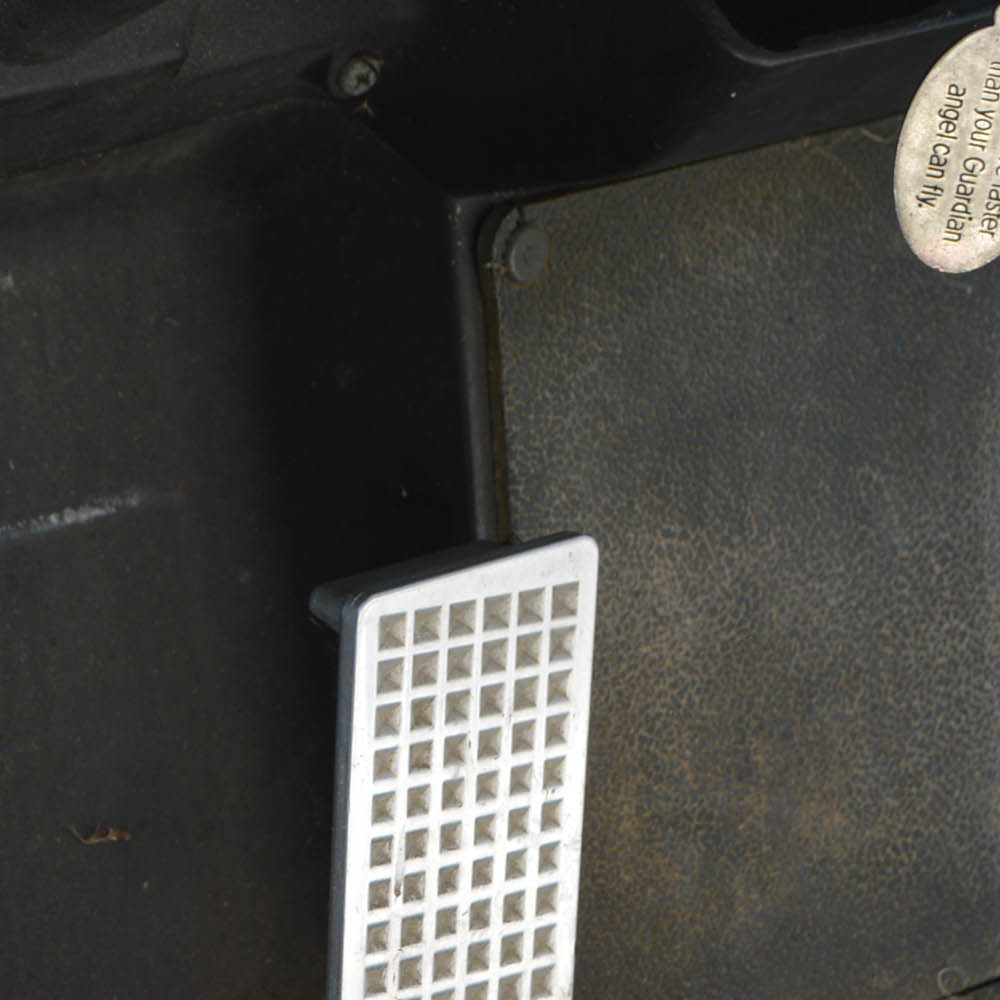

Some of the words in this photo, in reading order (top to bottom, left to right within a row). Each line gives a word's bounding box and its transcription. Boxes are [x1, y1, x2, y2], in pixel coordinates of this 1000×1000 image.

[936, 83, 966, 139] angel
[968, 107, 995, 151] your
[926, 143, 950, 179] can
[915, 184, 944, 207] fly.
[942, 156, 986, 242] Guardian
